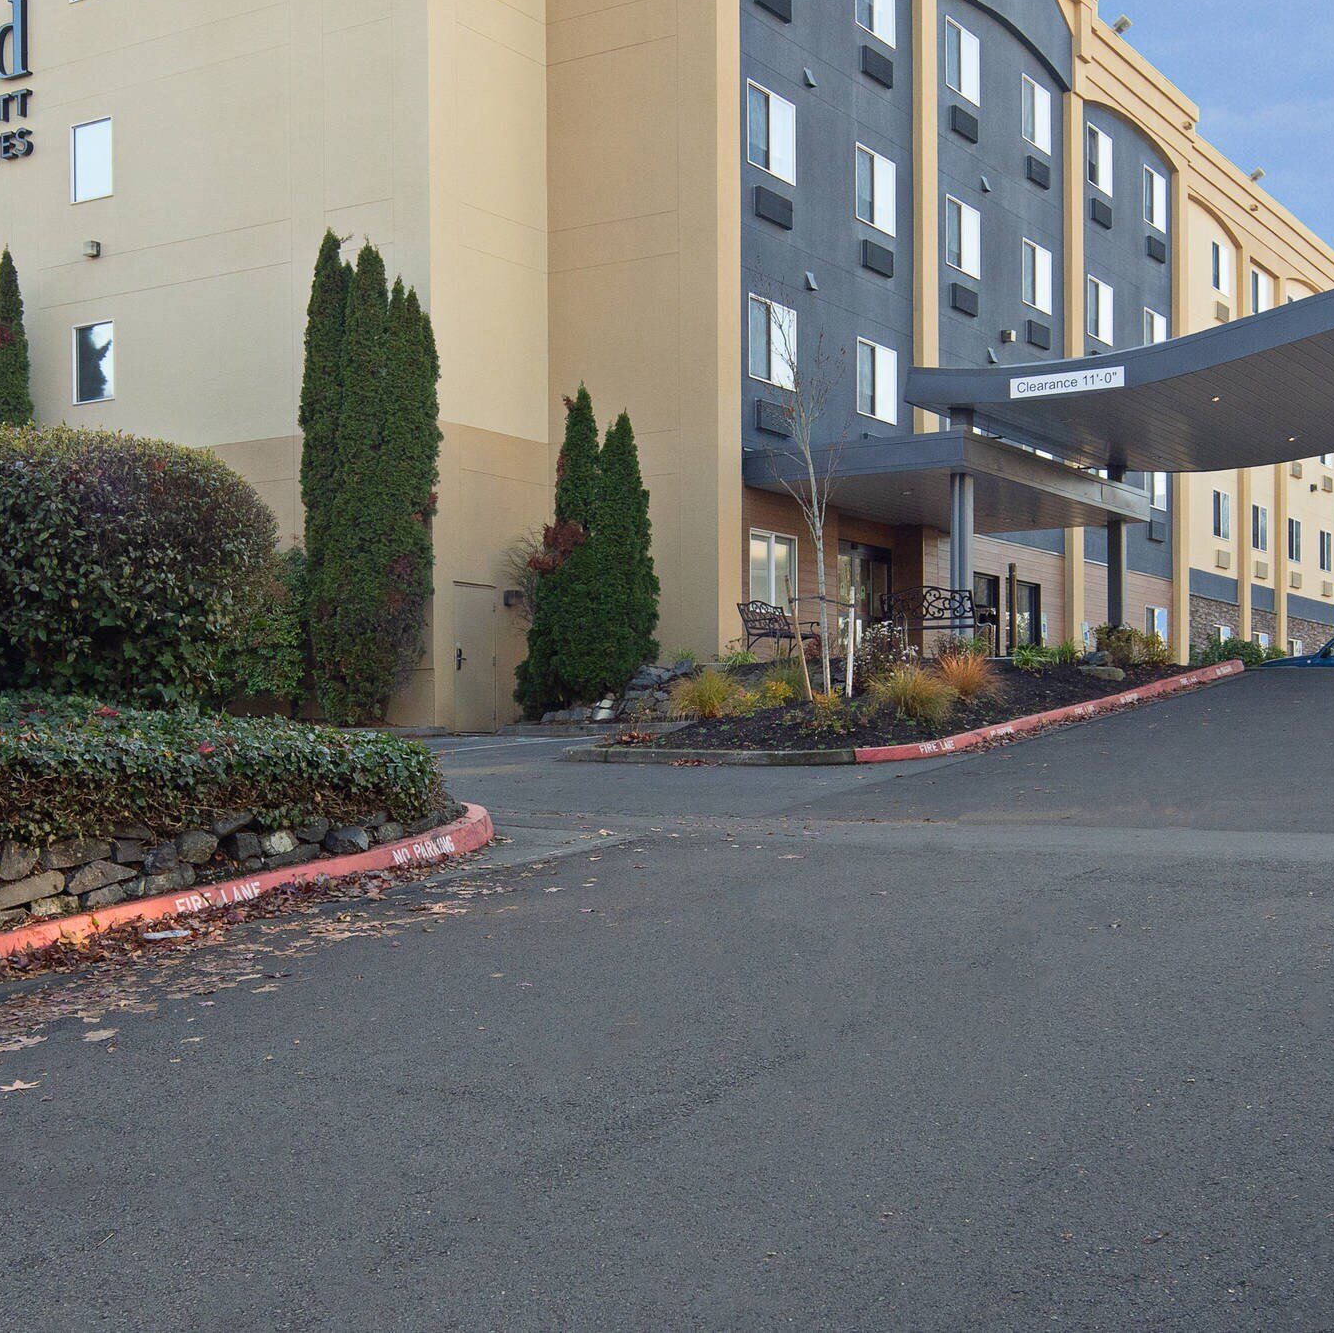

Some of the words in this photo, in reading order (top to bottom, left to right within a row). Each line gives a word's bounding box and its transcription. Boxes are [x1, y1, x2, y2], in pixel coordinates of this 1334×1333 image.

[1017, 378, 1078, 394] Clearance
[392, 848, 411, 865] NO
[412, 835, 455, 859] PARKING
